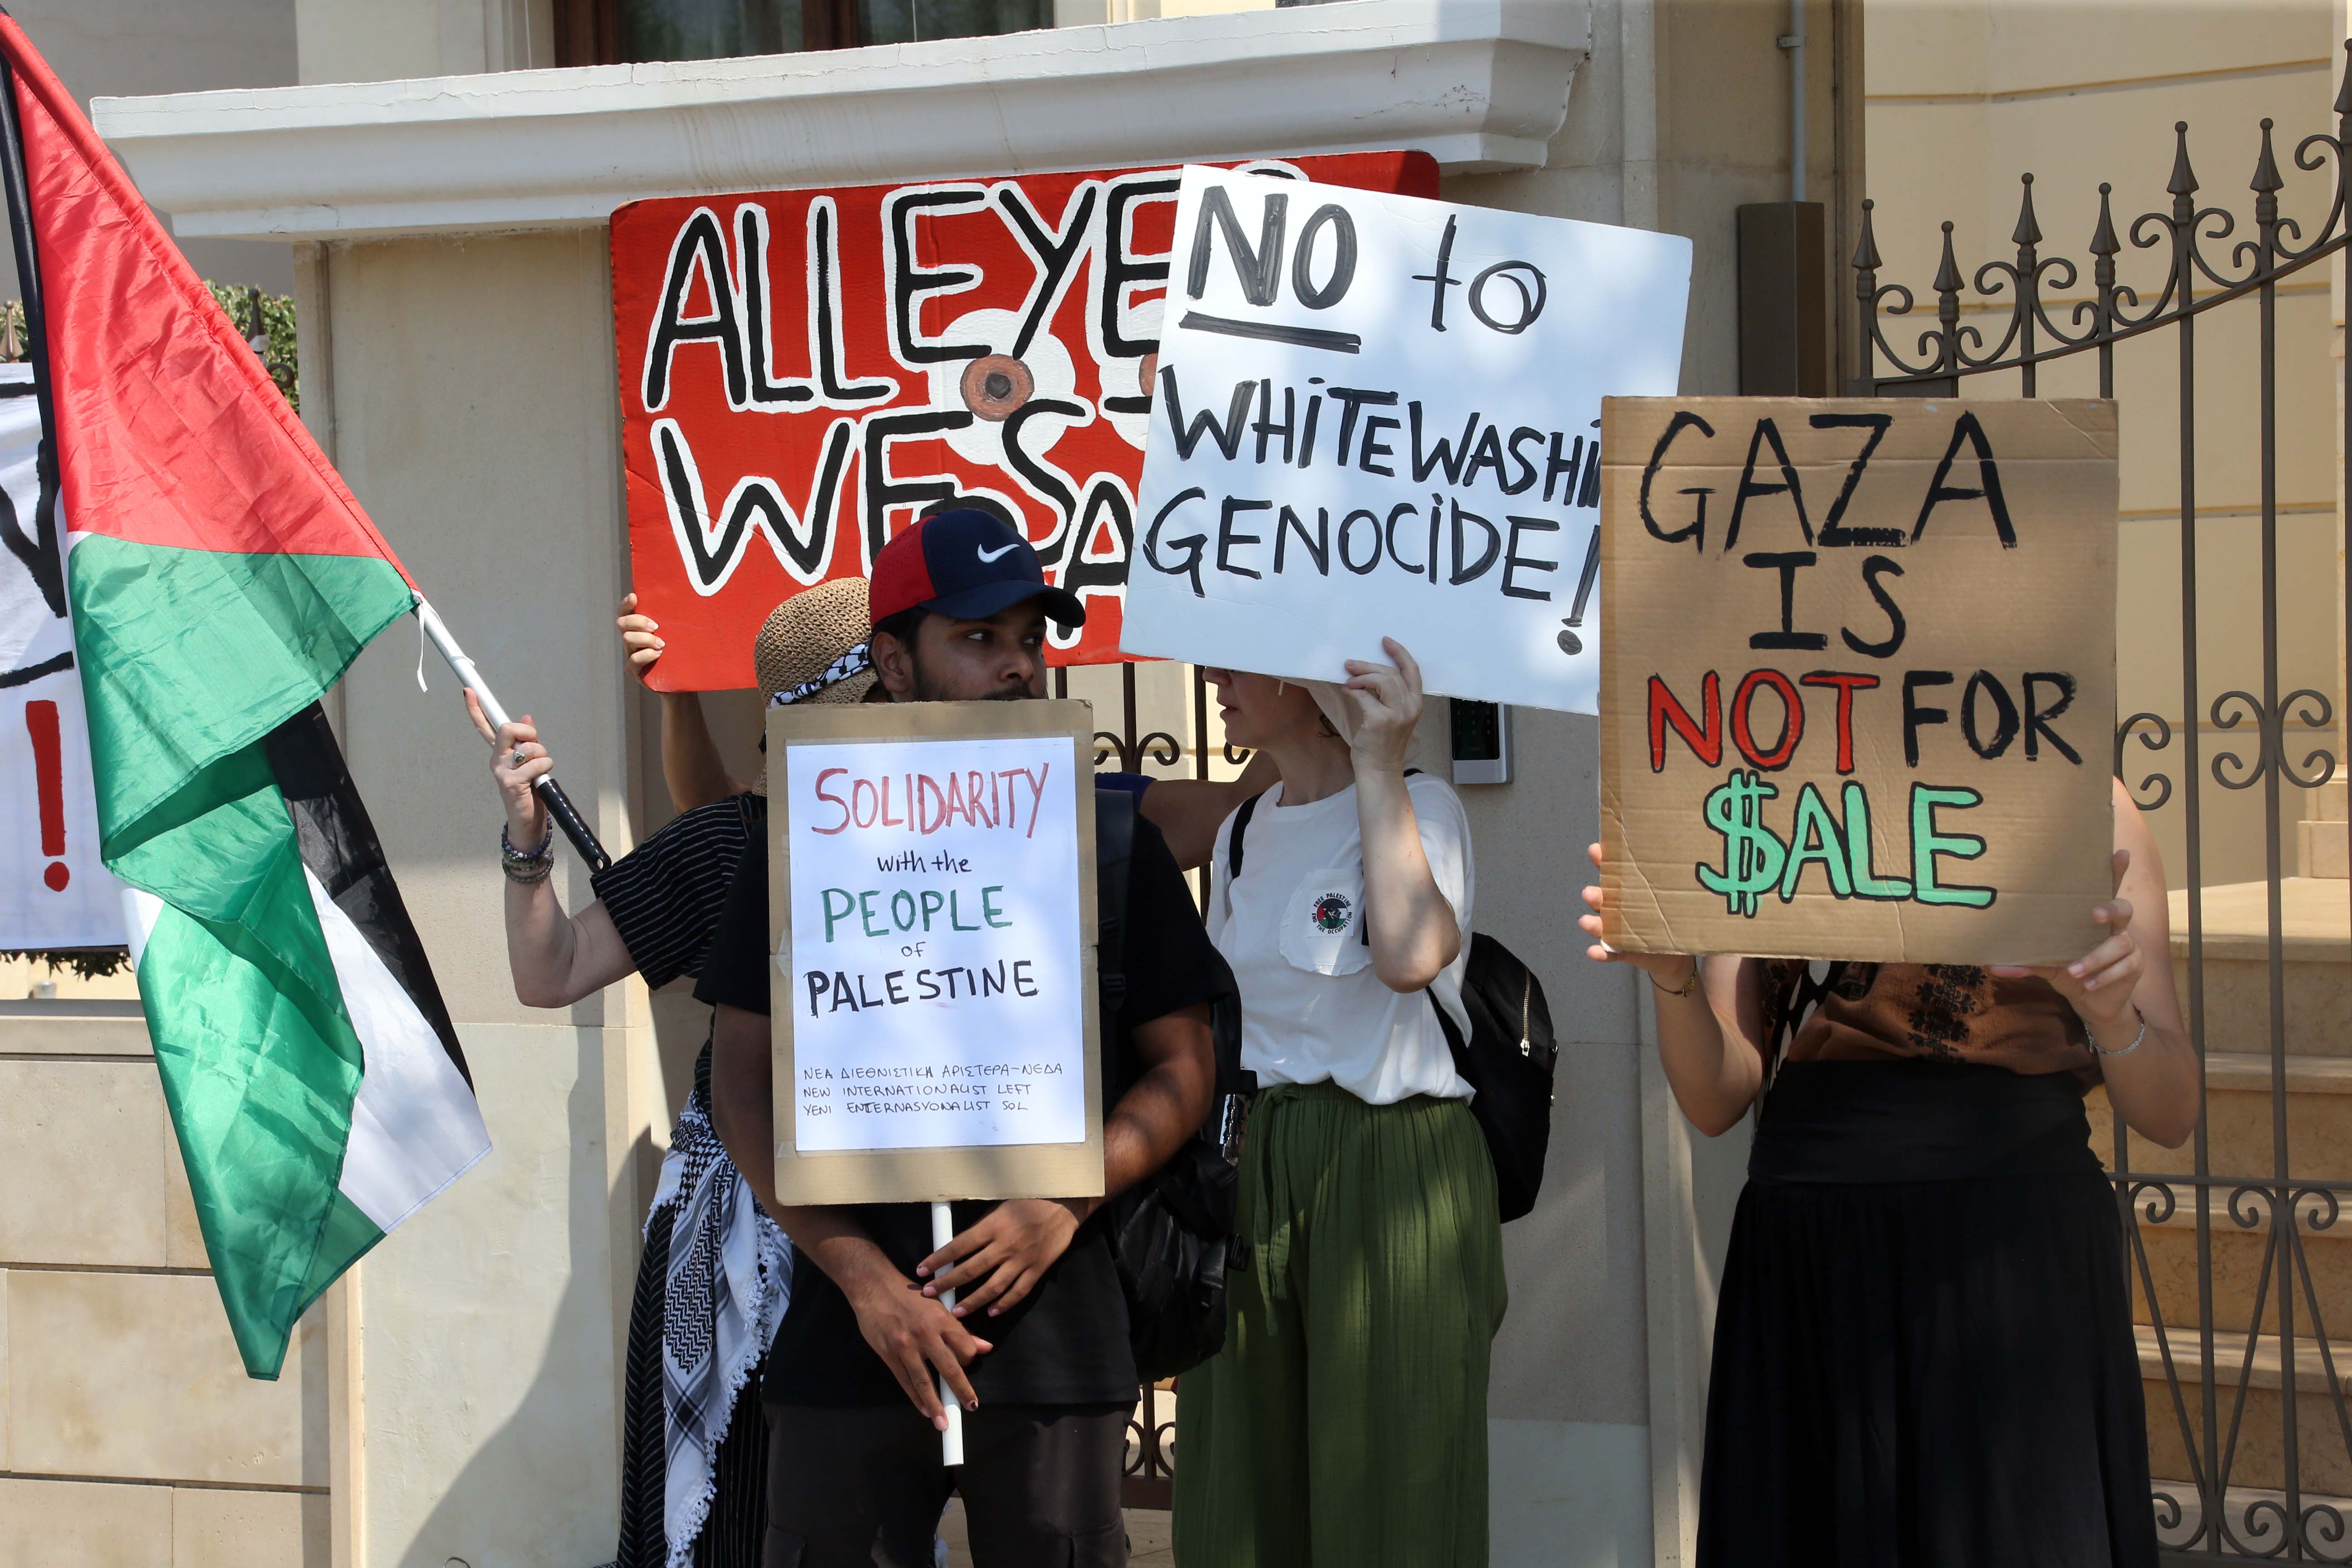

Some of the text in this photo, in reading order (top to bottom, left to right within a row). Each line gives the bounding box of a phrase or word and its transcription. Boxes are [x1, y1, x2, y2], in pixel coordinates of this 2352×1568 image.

[644, 168, 1298, 405] ALL EYE
[1186, 185, 1547, 336] NO to
[1157, 364, 1601, 508] WHITEWASHI
[659, 395, 1152, 588] WES
[1639, 410, 2017, 554] GAZA
[1742, 551, 1906, 659] IS
[1647, 669, 2083, 774] NOT FOR
[811, 762, 1049, 839] SOLIDARITY
[1695, 768, 1998, 919] $ALE
[877, 849, 972, 874] with the
[1313, 892, 1352, 908] FREE PALESTINE
[820, 885, 1013, 943] PEOPLE
[1316, 924, 1325, 932] THE
[1328, 911, 1352, 934] OCCUPATION
[803, 959, 1040, 1019] PALESTINE
[803, 1104, 832, 1116] YENI
[1002, 1100, 1029, 1111] SOL
[804, 1083, 1032, 1098] NEW INTERNATIONALIST LEFT
